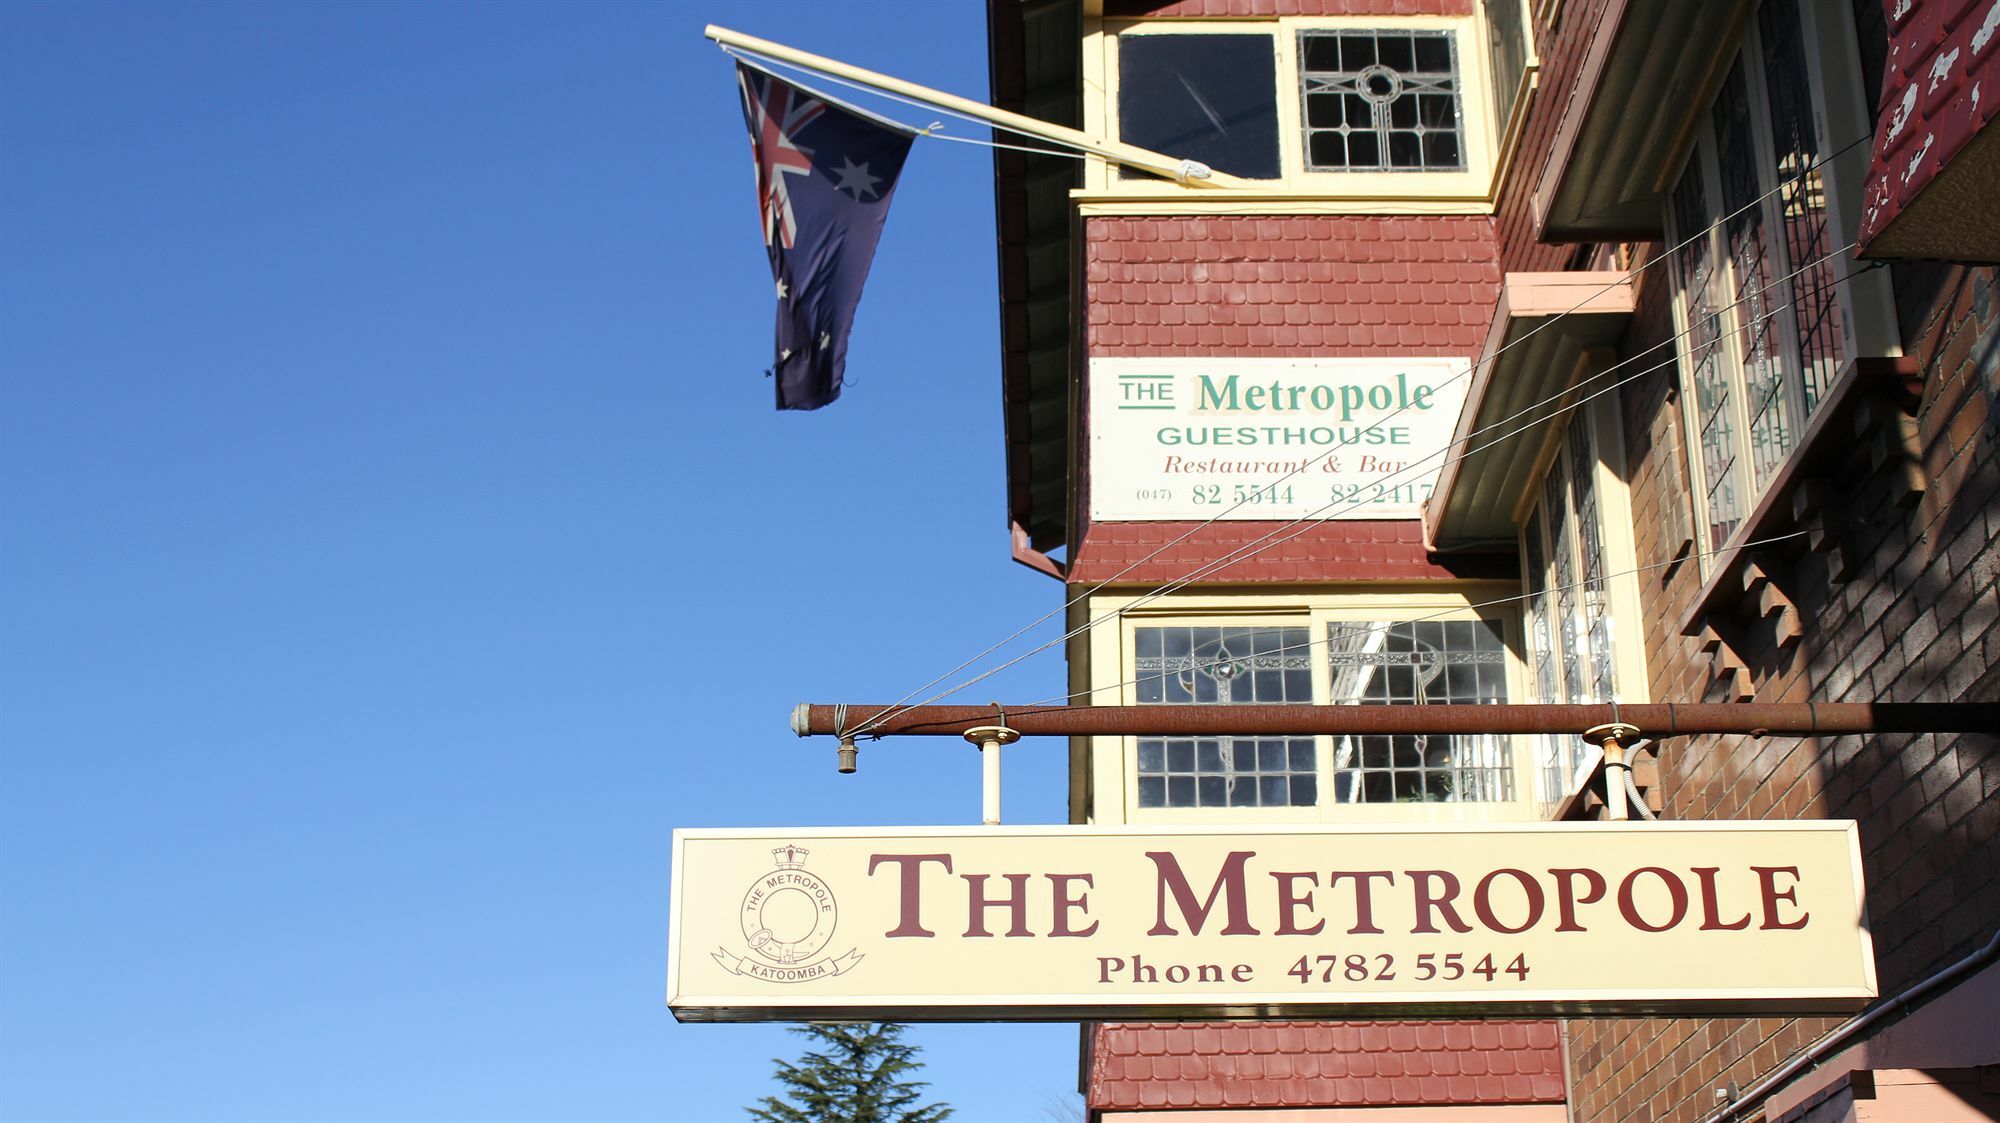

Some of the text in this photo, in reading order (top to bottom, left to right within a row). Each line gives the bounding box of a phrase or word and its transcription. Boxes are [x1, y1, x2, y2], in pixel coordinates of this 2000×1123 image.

[1118, 373, 1435, 422] THE Metropole
[1156, 427, 1411, 445] GUESTHOUSE
[1162, 455, 1408, 474] Restaurant & Bar
[1136, 483, 1433, 505] (047) 82 5544 82 2417
[747, 874, 832, 913] THE METROPOLE
[867, 849, 1811, 938] THE METROPOLE
[751, 964, 826, 980] KATOOMBA
[1096, 952, 1531, 985] Phone 4782 5544
